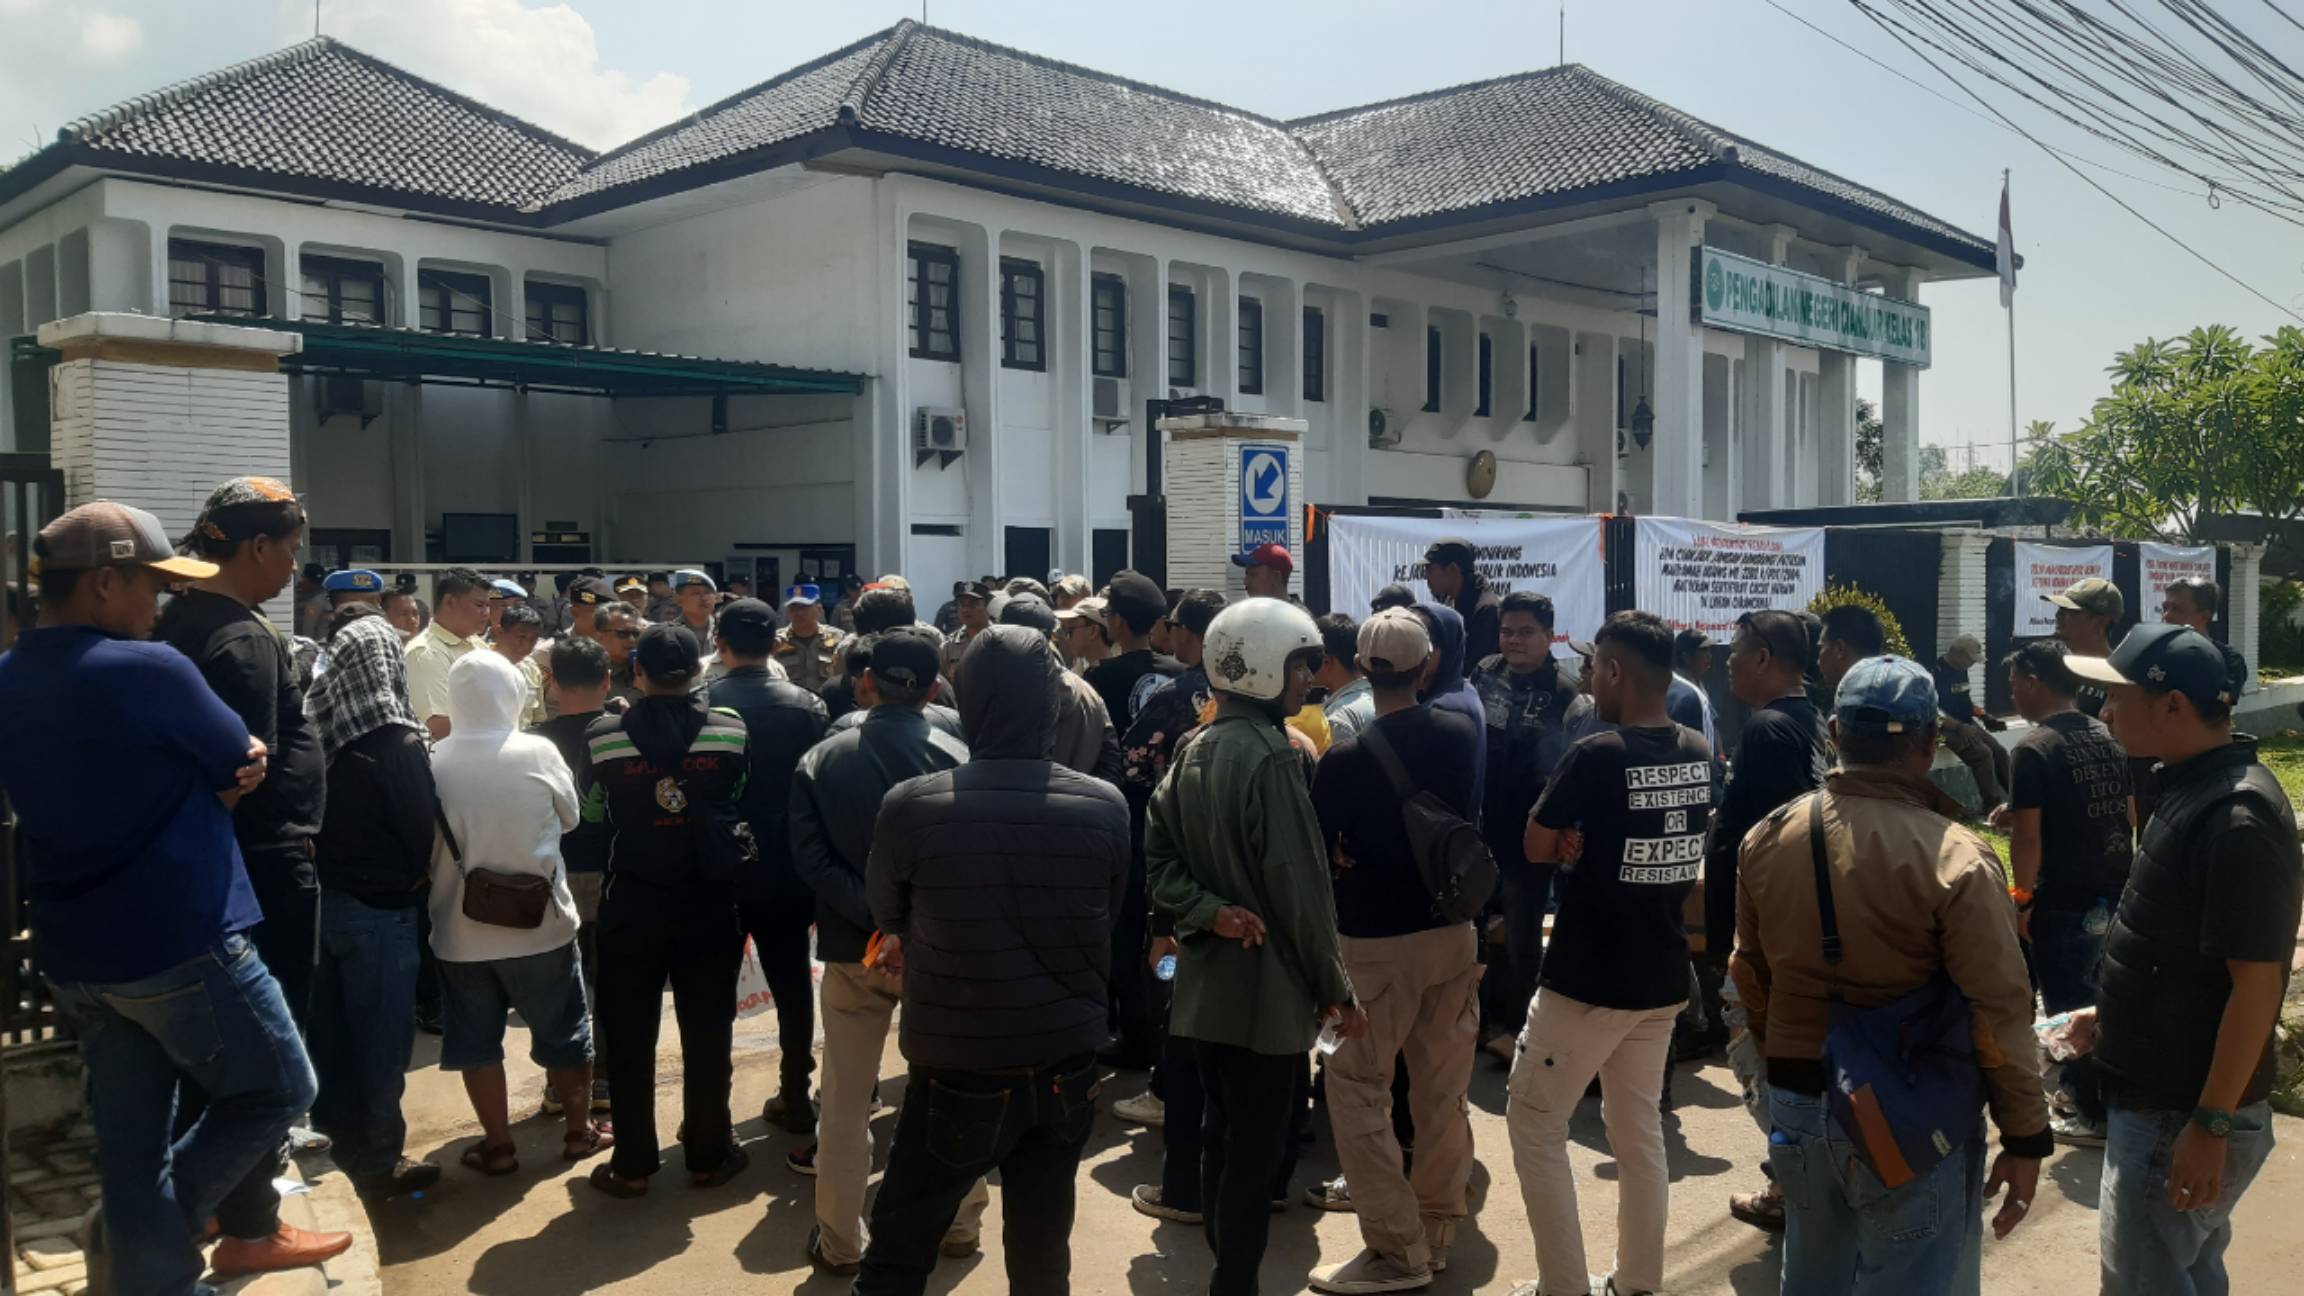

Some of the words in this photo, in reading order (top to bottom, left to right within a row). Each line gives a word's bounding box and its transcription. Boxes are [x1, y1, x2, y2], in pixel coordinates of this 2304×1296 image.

[1726, 271, 1798, 323] PENGADILAN
[1799, 290, 1838, 332] NEGERI
[1884, 311, 1912, 348] KELAS
[1244, 529, 1286, 545] MASUK
[1505, 562, 1557, 579] INDONESIA
[1627, 763, 1709, 786] RESPECT
[1630, 788, 1710, 807] EXISTENCE
[1666, 813, 1685, 831] OR
